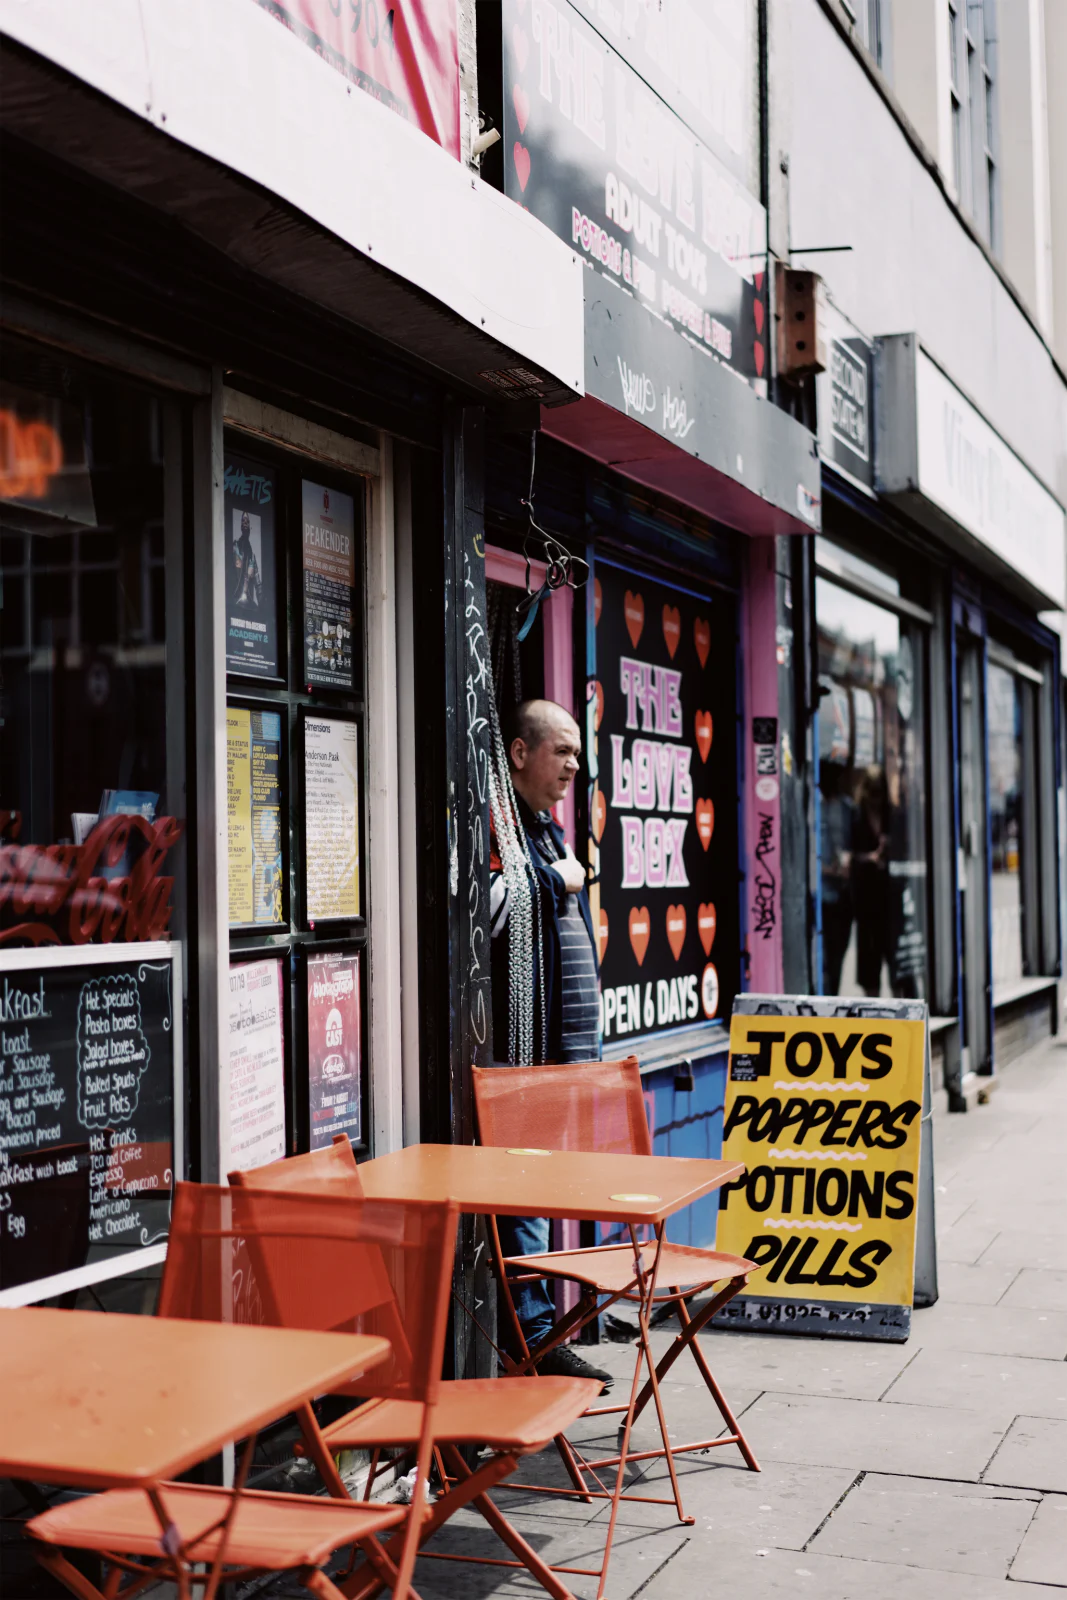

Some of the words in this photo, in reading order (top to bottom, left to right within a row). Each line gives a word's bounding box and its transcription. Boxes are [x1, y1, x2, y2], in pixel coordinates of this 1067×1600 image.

[571, 205, 622, 276] POTIONS
[605, 172, 661, 259] ADULT
[664, 222, 708, 297] TOYS
[304, 523, 350, 556] PEAKENDER
[228, 627, 263, 643] ACADEMY
[263, 634, 269, 643] 2
[619, 656, 683, 739] THE
[609, 733, 694, 814] LOVE
[620, 815, 691, 889] BOX
[0, 976, 48, 1021] kfast
[86, 991, 101, 1011] Hot
[102, 987, 135, 1015] Specials
[643, 981, 655, 1028] 6
[656, 974, 699, 1026] DAYS
[85, 1013, 111, 1036] Pasta
[112, 1012, 137, 1033] boxes
[2, 1026, 32, 1055] toast
[84, 1038, 109, 1061] Salad
[111, 1037, 136, 1056] boxes
[325, 1029, 343, 1048] CAST
[12, 1053, 51, 1075] Sausage
[746, 1031, 894, 1080] TOYS
[17, 1071, 56, 1091] Sausage
[86, 1074, 111, 1096] Baked
[112, 1070, 136, 1095] Spuds
[32, 1087, 66, 1111] Sausage
[83, 1098, 107, 1119] Fruit
[109, 1094, 131, 1114] Pots
[6, 1110, 36, 1130] Bacon
[722, 1095, 922, 1149] POPPERS
[36, 1123, 62, 1146] priced
[89, 1132, 106, 1153] Hot
[56, 1155, 79, 1175] toast
[90, 1154, 105, 1170] Tea
[106, 1152, 120, 1167] and
[120, 1147, 143, 1164] Coffee
[89, 1166, 124, 1190] Espresso
[112, 1183, 121, 1199] or
[121, 1173, 159, 1198] Cappuccino
[718, 1165, 915, 1220] POTIONS
[89, 1198, 131, 1221] Americano
[8, 1213, 26, 1239] Egg
[88, 1222, 104, 1241] Hot
[105, 1211, 141, 1236] Chocolate
[743, 1234, 893, 1289] PILLS
